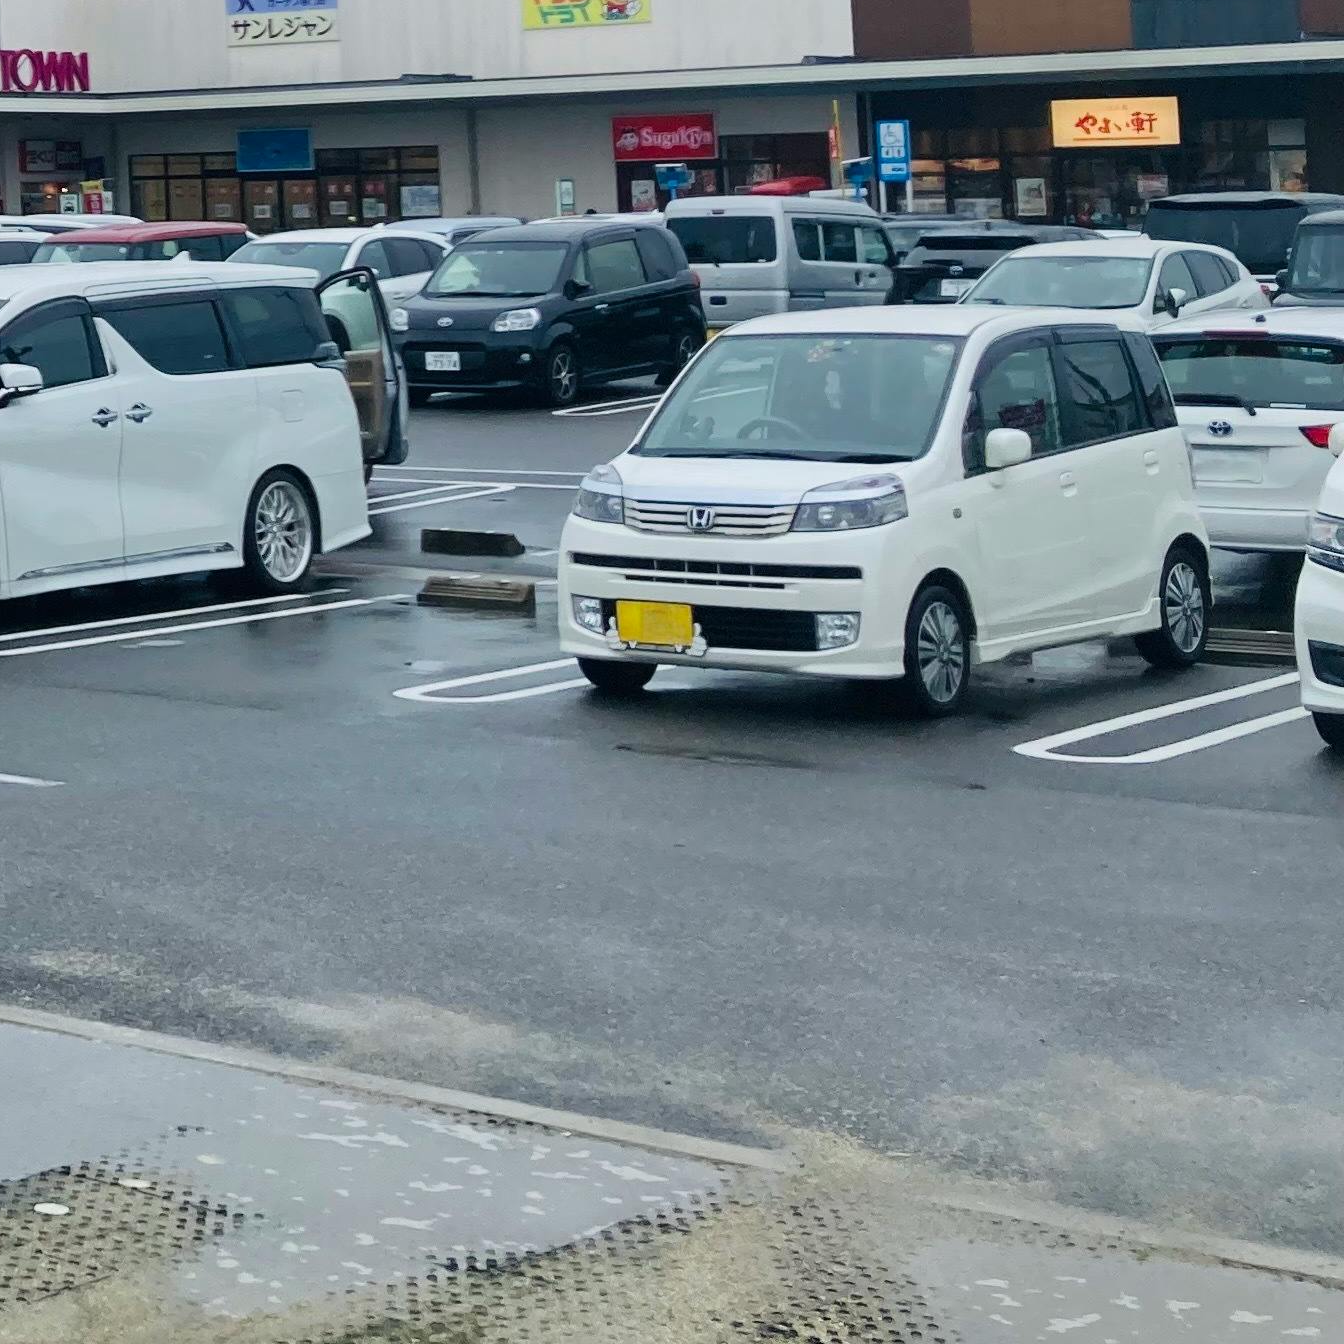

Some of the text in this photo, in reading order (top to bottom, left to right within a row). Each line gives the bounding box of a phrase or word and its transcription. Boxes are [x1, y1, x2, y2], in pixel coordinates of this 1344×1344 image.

[232, 16, 333, 40] サンレジャン
[1074, 111, 1158, 135] やよい軒
